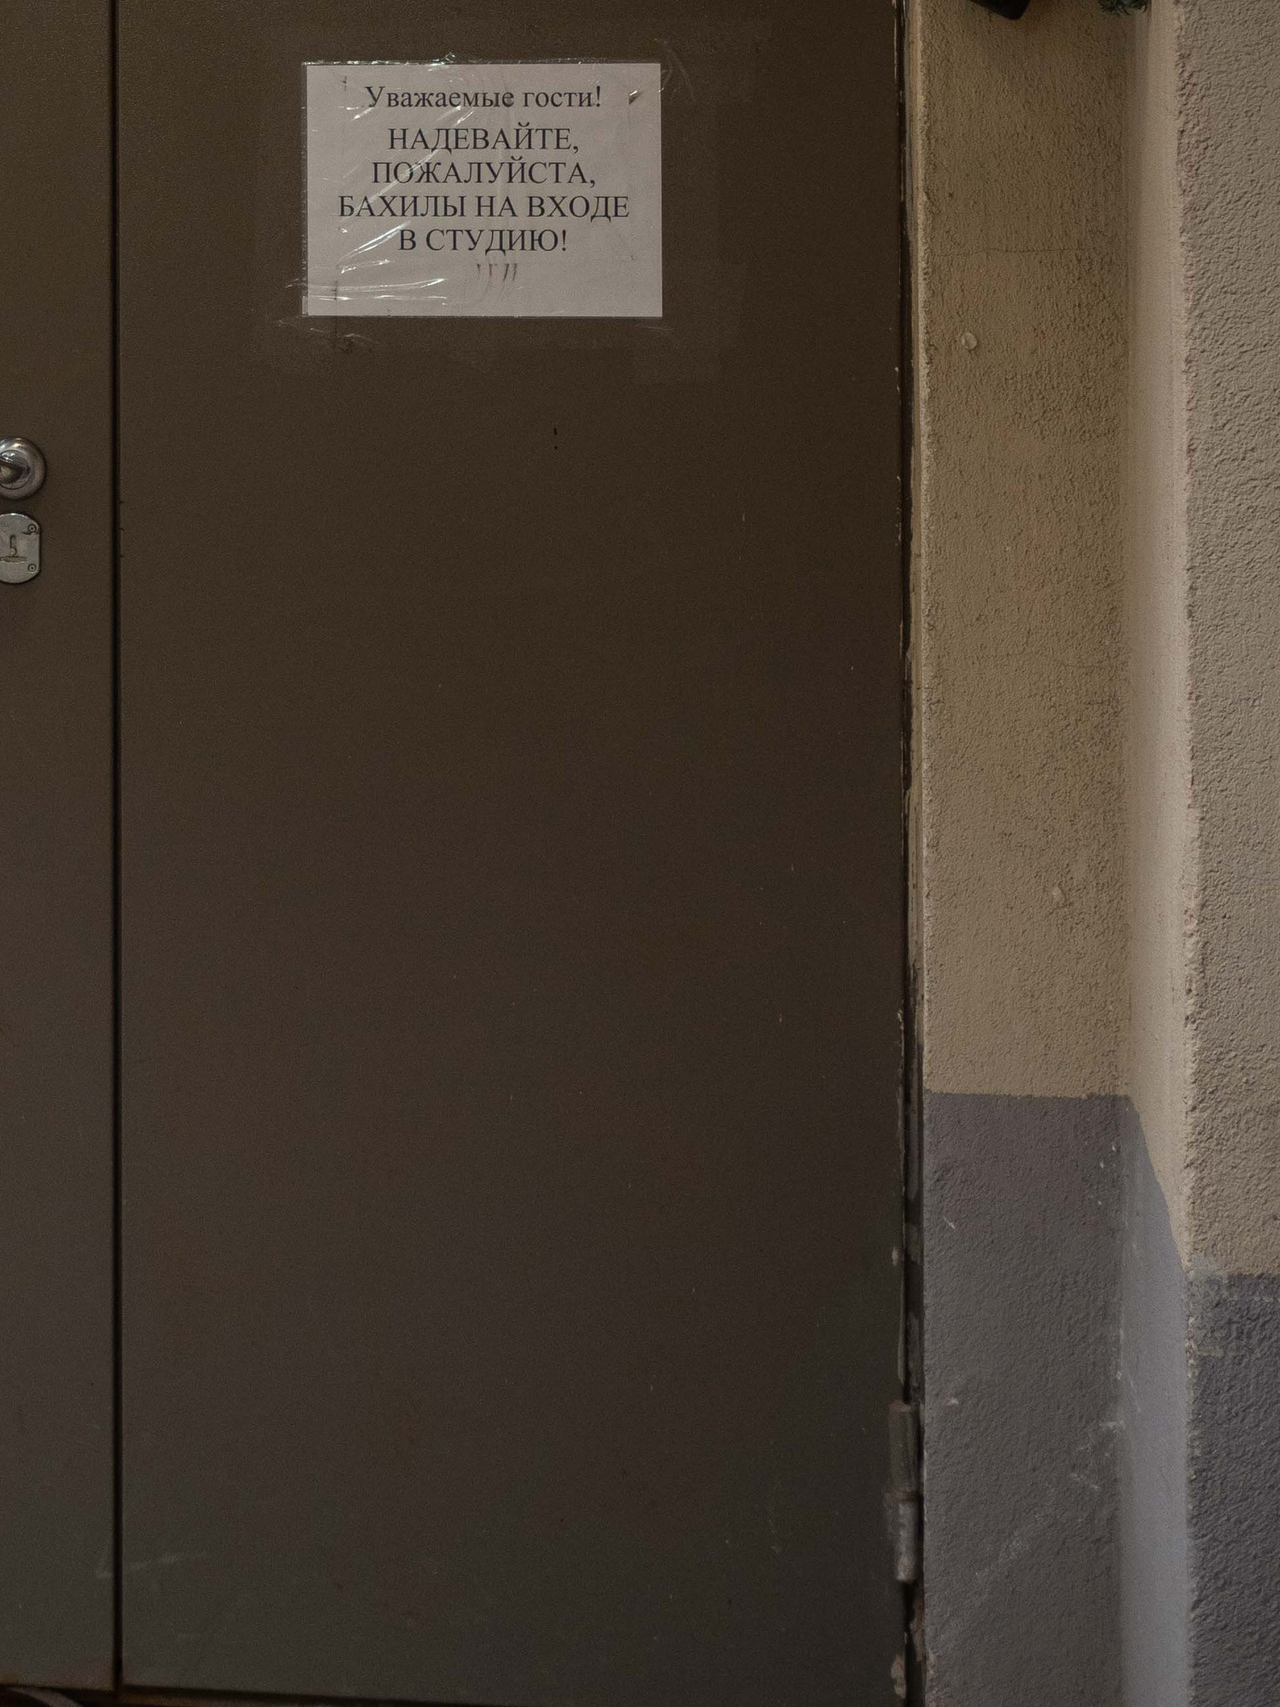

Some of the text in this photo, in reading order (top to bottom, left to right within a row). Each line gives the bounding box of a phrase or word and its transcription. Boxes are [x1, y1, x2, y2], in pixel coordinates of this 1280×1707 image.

[364, 85, 601, 108] Уважаемые гости!
[388, 122, 579, 154] НАДЕВАЙТЕ,
[372, 156, 596, 188] ПОЖАЛУЙСТА,
[339, 195, 630, 222] БАХИЛЫ НА ВХОДЕ
[398, 228, 567, 256] В СТУДИЮ!
